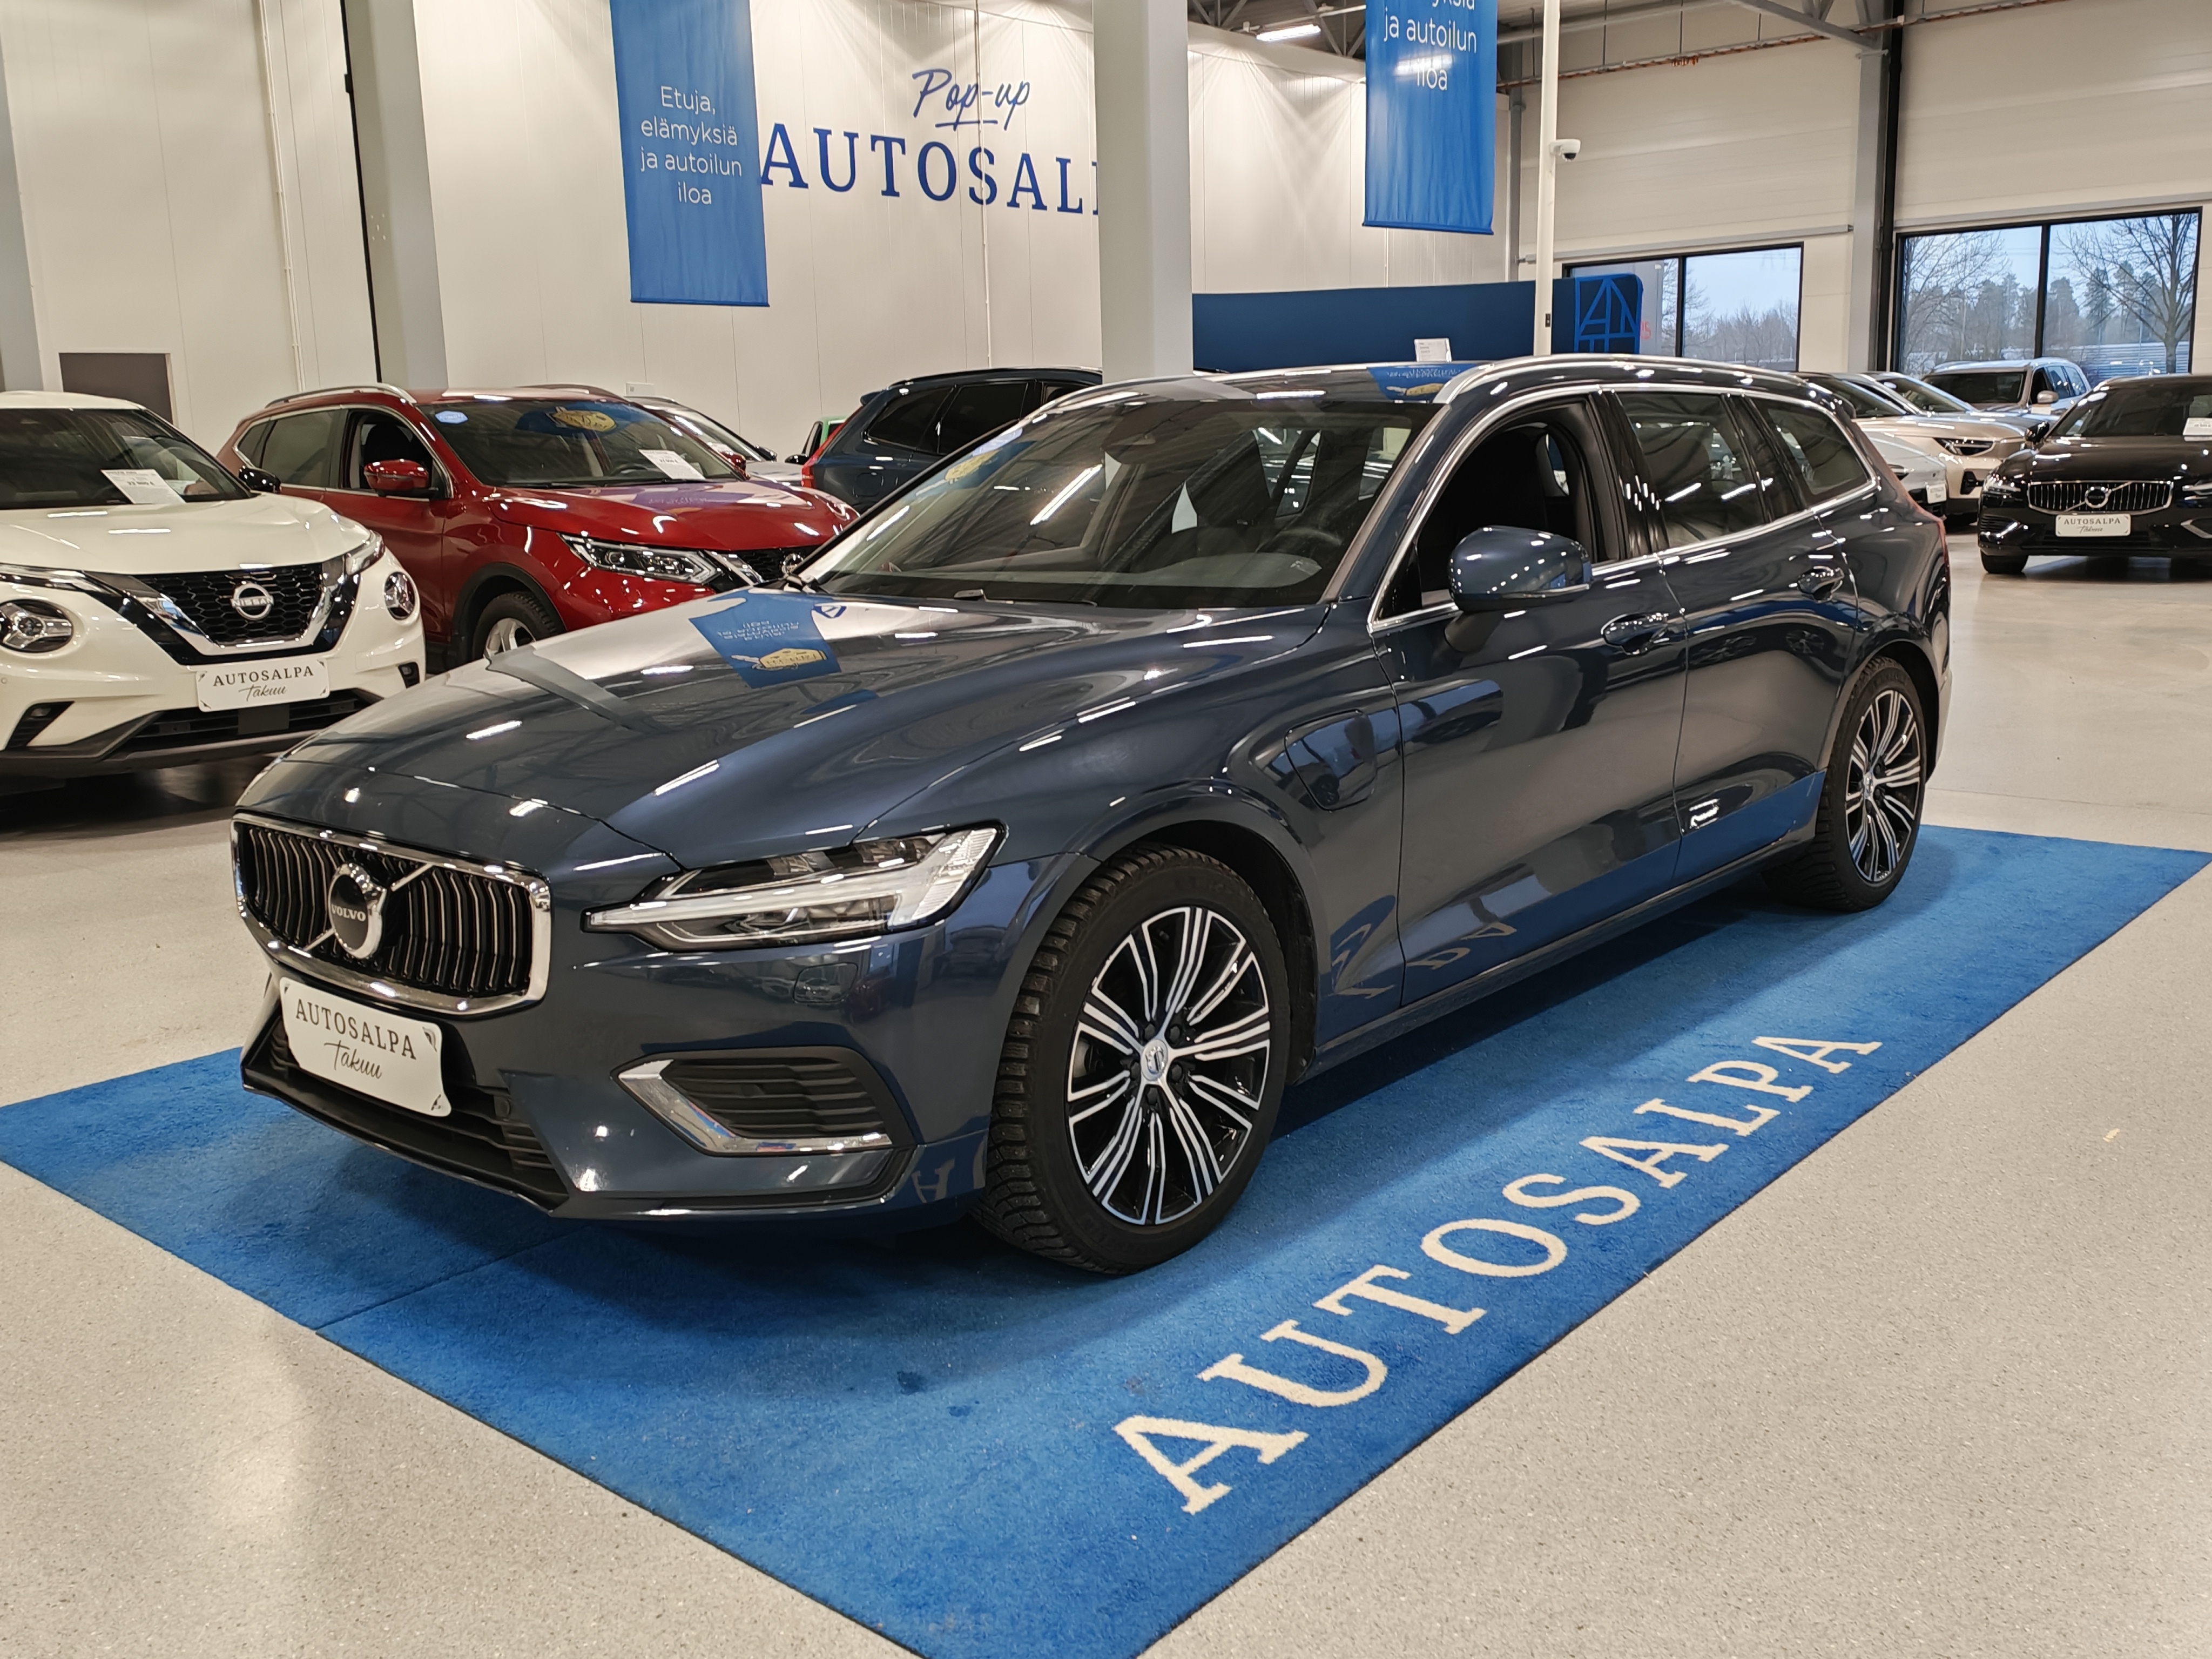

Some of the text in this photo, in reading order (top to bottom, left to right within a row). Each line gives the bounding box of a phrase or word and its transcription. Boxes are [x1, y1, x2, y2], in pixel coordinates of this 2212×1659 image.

[1384, 6, 1477, 53] ja autoilun
[1417, 57, 1448, 91] iloa
[660, 85, 716, 115] Etuja,
[912, 69, 1030, 131] Pop-up
[641, 115, 737, 146] elämyksiä
[640, 146, 742, 177] ja autoilun
[760, 122, 1099, 215] AUTOSAL
[678, 180, 712, 205] iloa
[230, 595, 274, 608] NISSAN
[213, 665, 314, 686] AUTOSALPA
[238, 684, 287, 702] Takuu
[332, 903, 366, 921] VOLVO
[295, 999, 417, 1060] AUTOSALPA
[324, 1040, 382, 1079] Takuu
[1113, 1036, 1883, 1514] AUTOSALPA
